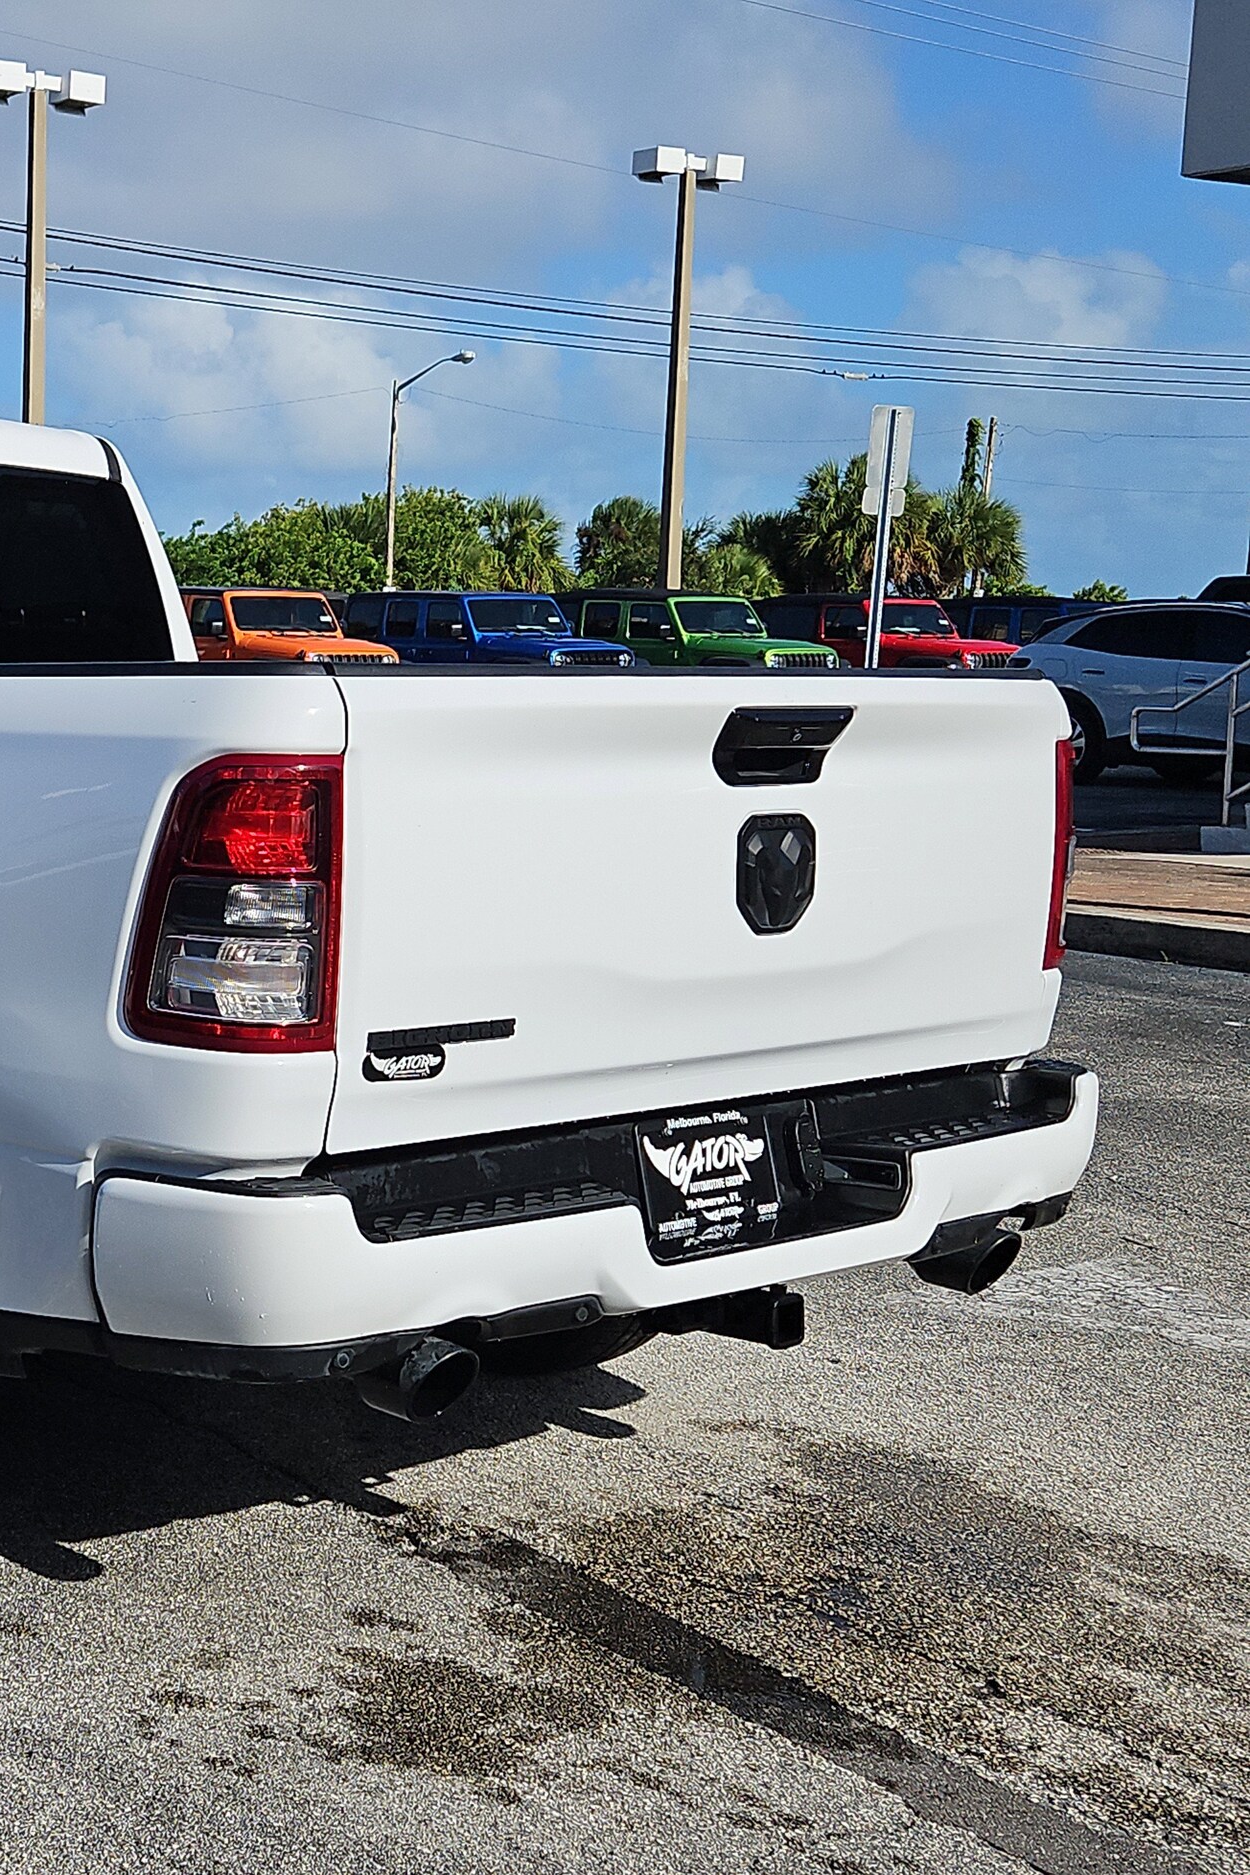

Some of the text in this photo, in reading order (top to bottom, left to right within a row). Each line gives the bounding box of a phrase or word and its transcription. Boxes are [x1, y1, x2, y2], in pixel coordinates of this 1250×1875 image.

[757, 816, 803, 828] RAM
[383, 1053, 430, 1079] GATOR
[712, 1110, 741, 1123] Florida
[669, 1134, 752, 1196] GATOR
[689, 1178, 726, 1194] AUTOMOTIVE
